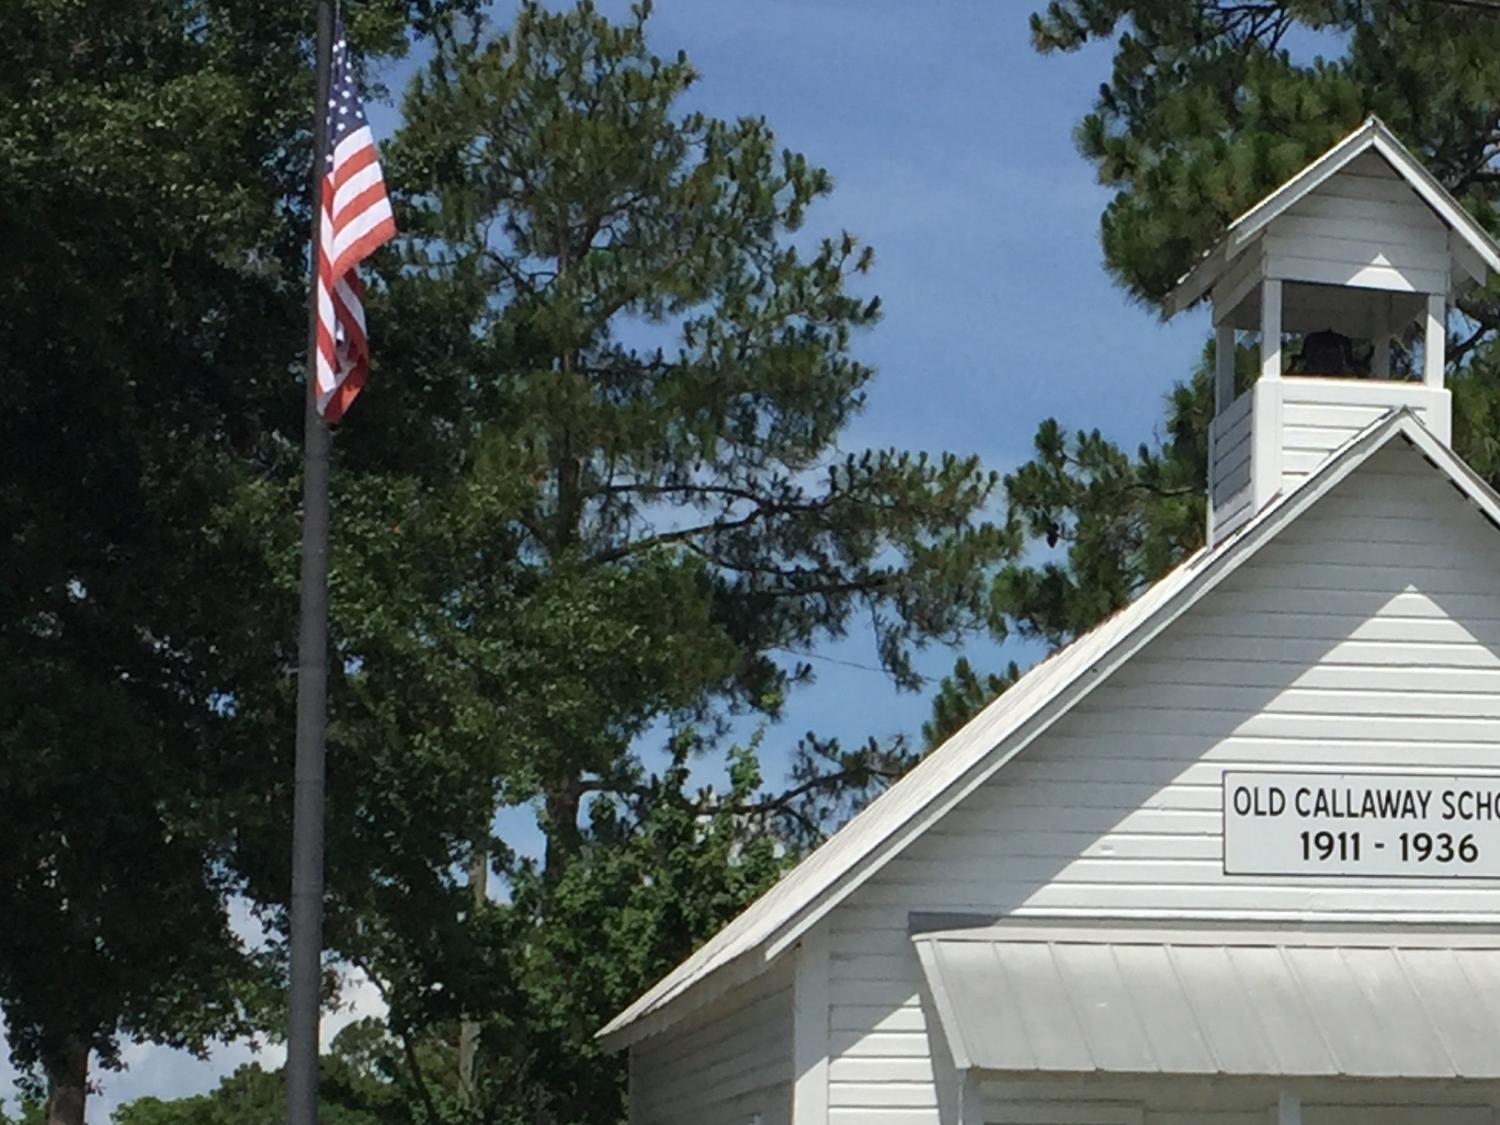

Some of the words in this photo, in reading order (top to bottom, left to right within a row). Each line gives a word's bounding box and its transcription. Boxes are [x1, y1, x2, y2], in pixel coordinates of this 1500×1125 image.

[1233, 786, 1286, 817] OLD
[1295, 788, 1432, 819] CALLAWAY
[1300, 831, 1360, 861] 1911
[1399, 833, 1479, 863] 1936
